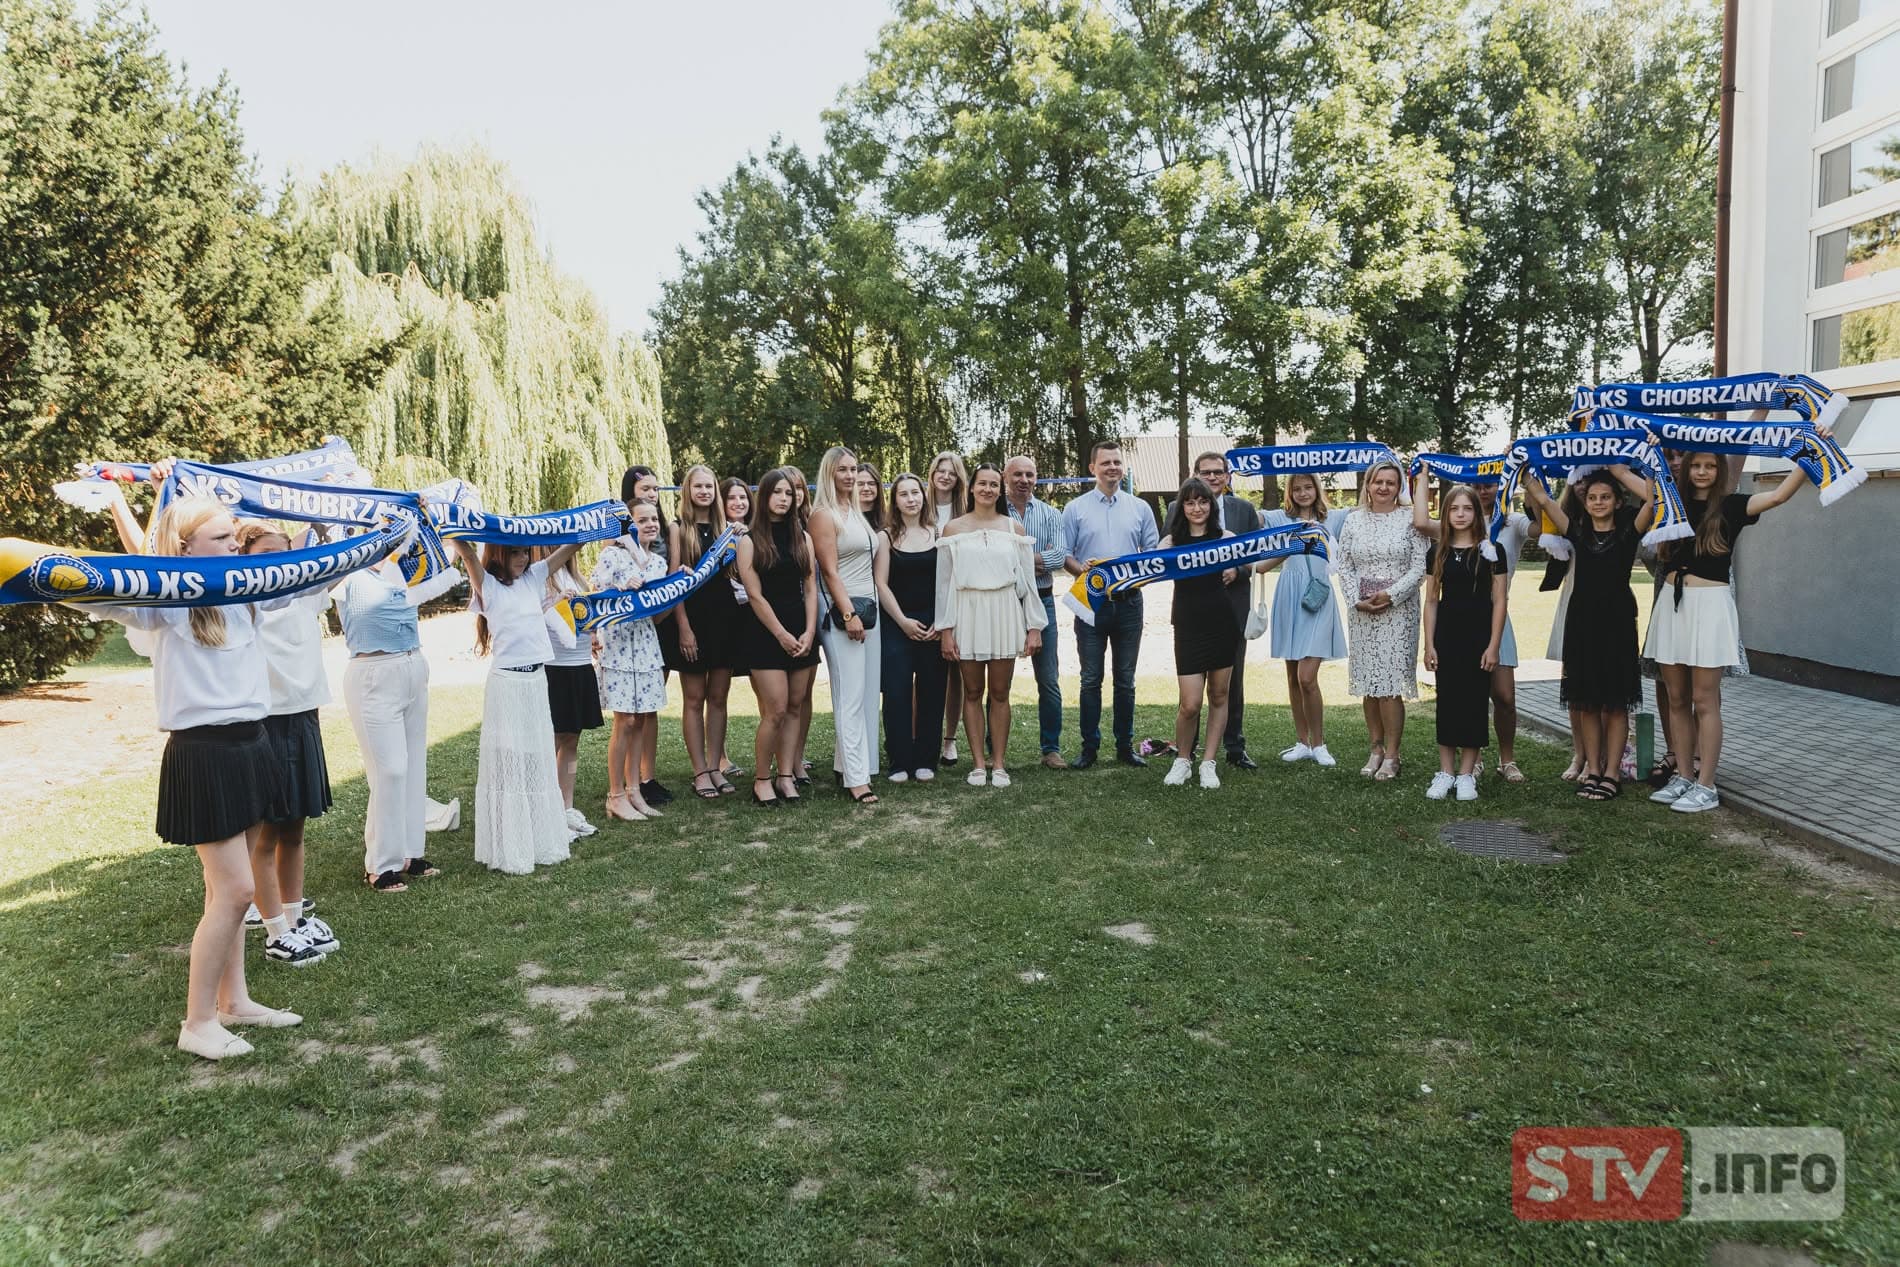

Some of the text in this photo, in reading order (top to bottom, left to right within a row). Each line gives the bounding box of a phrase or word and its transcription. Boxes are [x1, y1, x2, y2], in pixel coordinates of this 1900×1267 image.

[1578, 381, 1779, 409] ULKS CHOBRZANY
[1662, 423, 1801, 447] CHOBRZANY
[1228, 455, 1262, 472] LKS
[1540, 438, 1662, 472] CHOBRZAN
[499, 507, 608, 535] CHOBRZANY
[110, 539, 384, 600] ULKS CHOBRZANY
[1111, 532, 1293, 581] ULKS CHOBRZANY
[595, 594, 635, 616] ULKS
